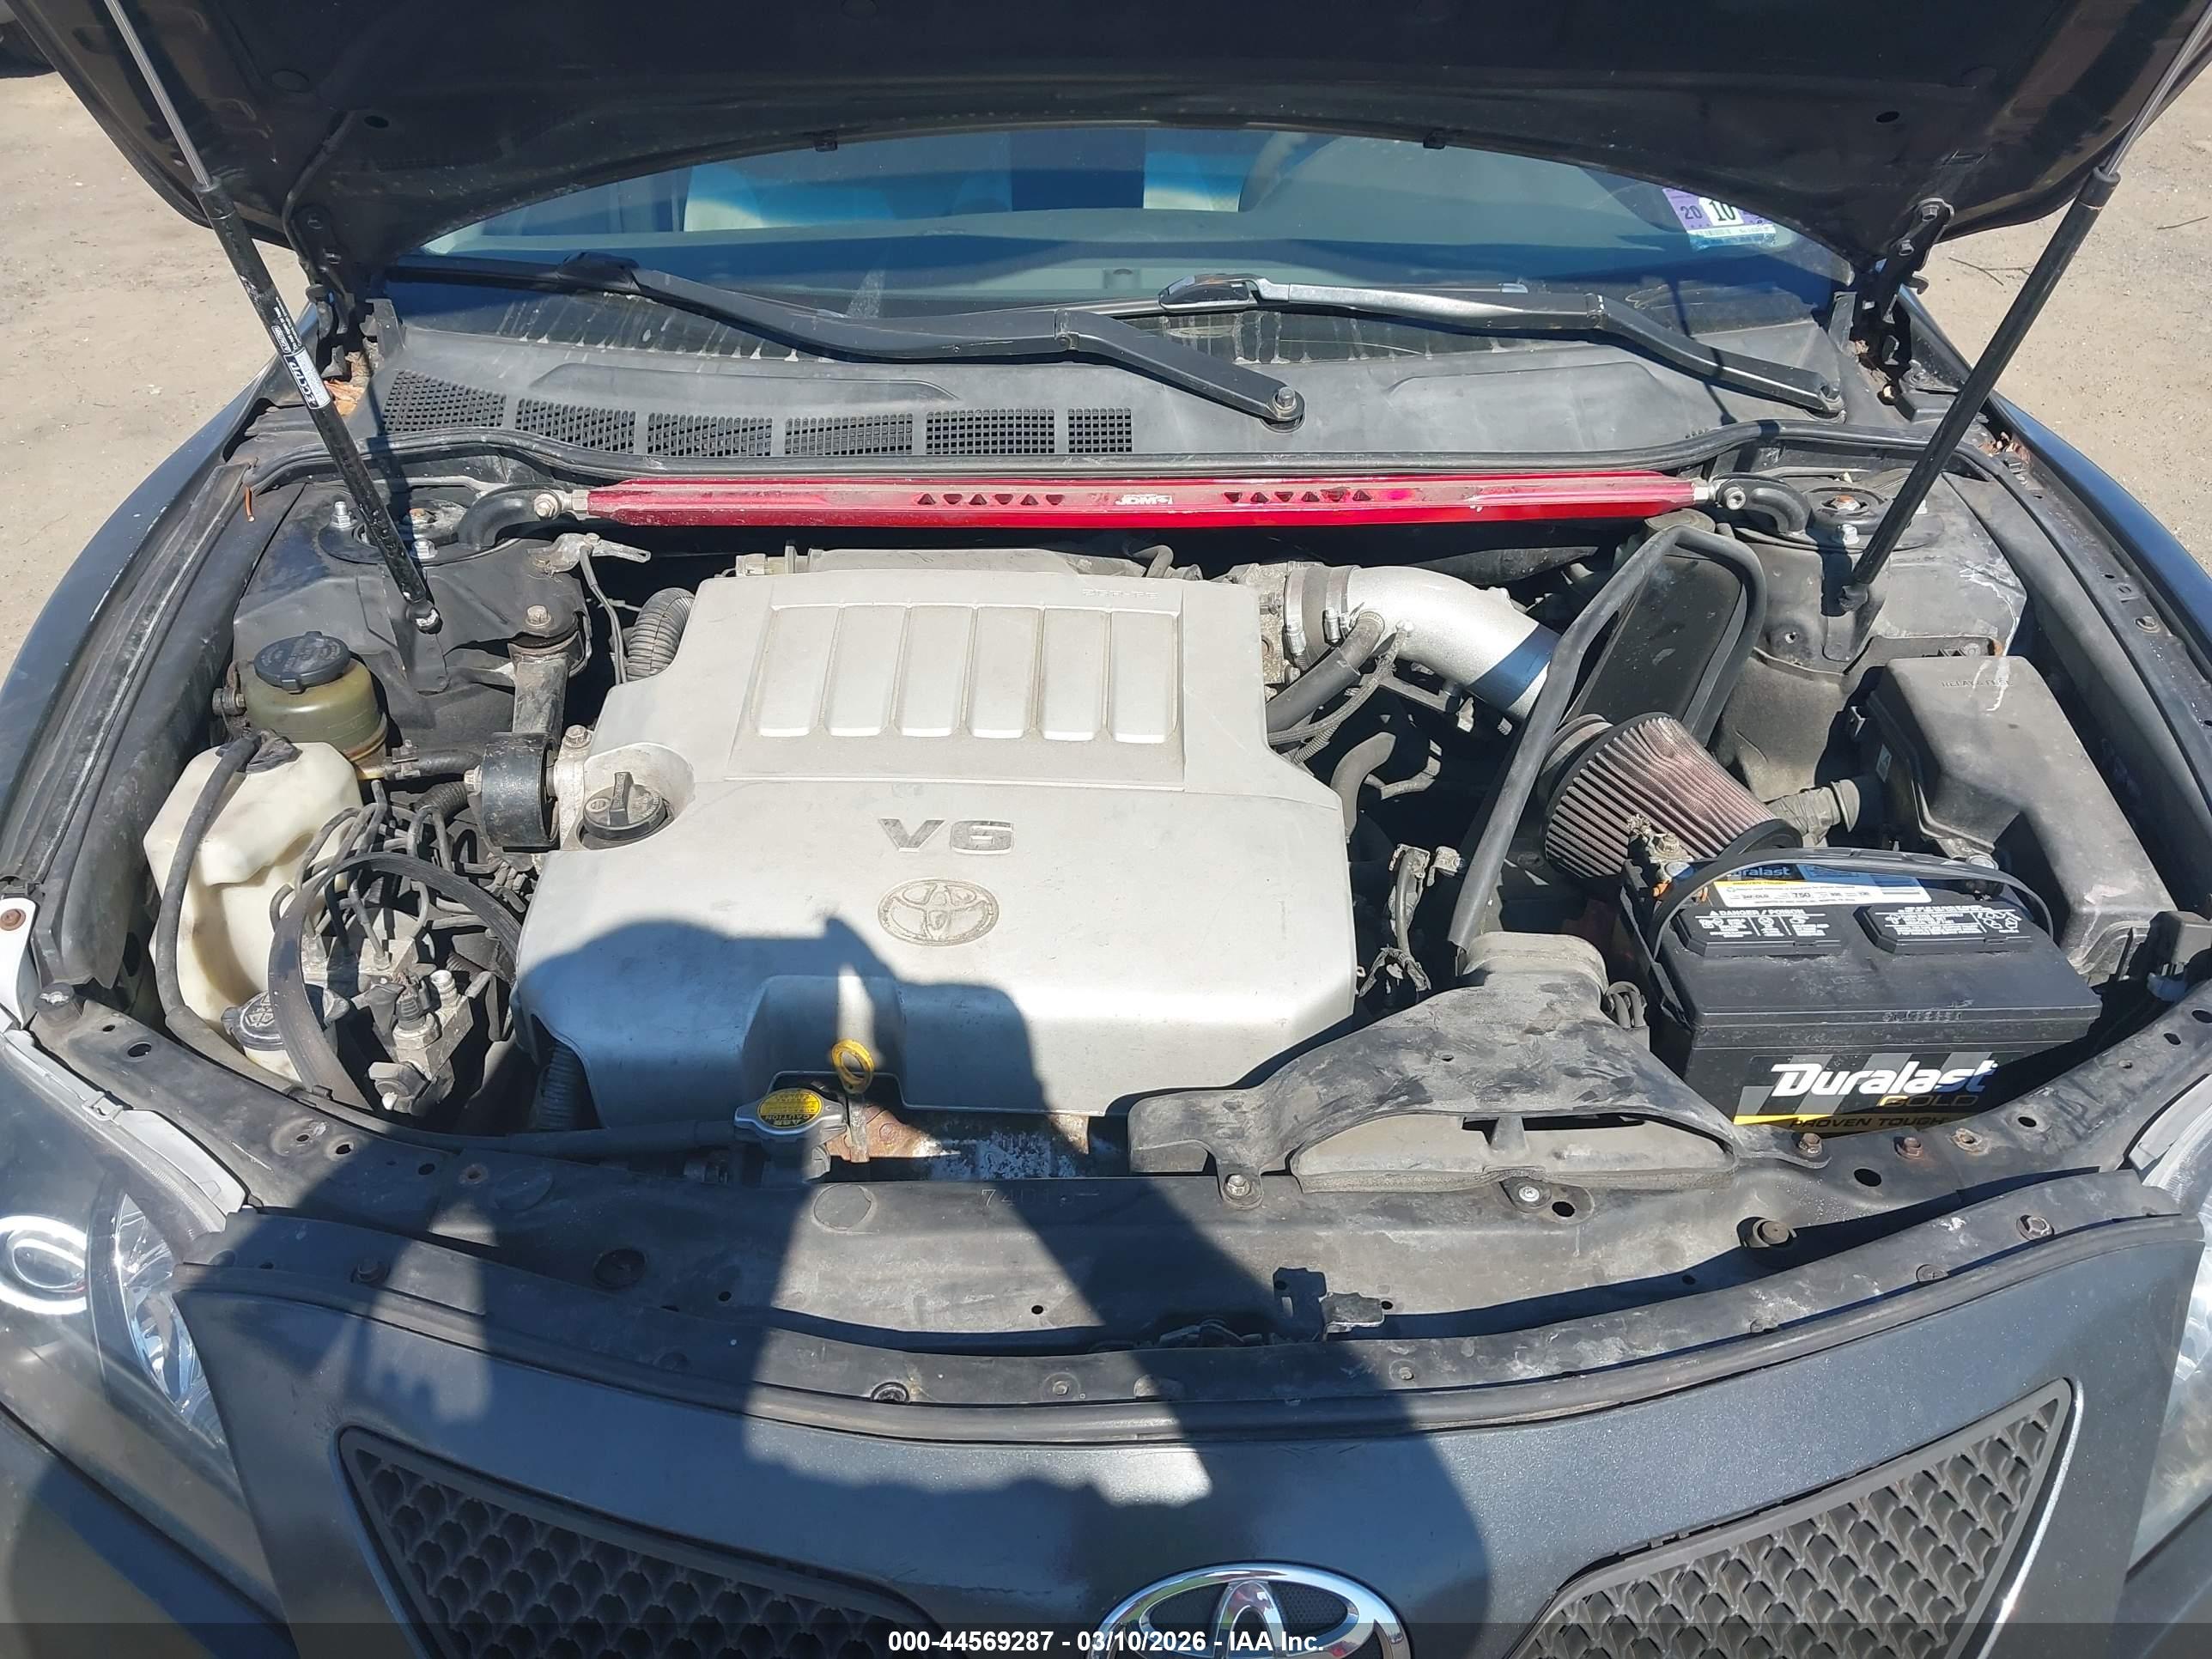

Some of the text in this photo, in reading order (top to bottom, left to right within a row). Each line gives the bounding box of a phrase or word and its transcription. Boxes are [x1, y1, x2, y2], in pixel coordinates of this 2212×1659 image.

[1680, 205, 1703, 220] 20
[1710, 201, 1735, 222] 10
[289, 361, 315, 402] ECCPP
[878, 817, 1014, 855] V6
[1771, 1060, 1999, 1097] Duralast
[1878, 1095, 1979, 1108] GOLD
